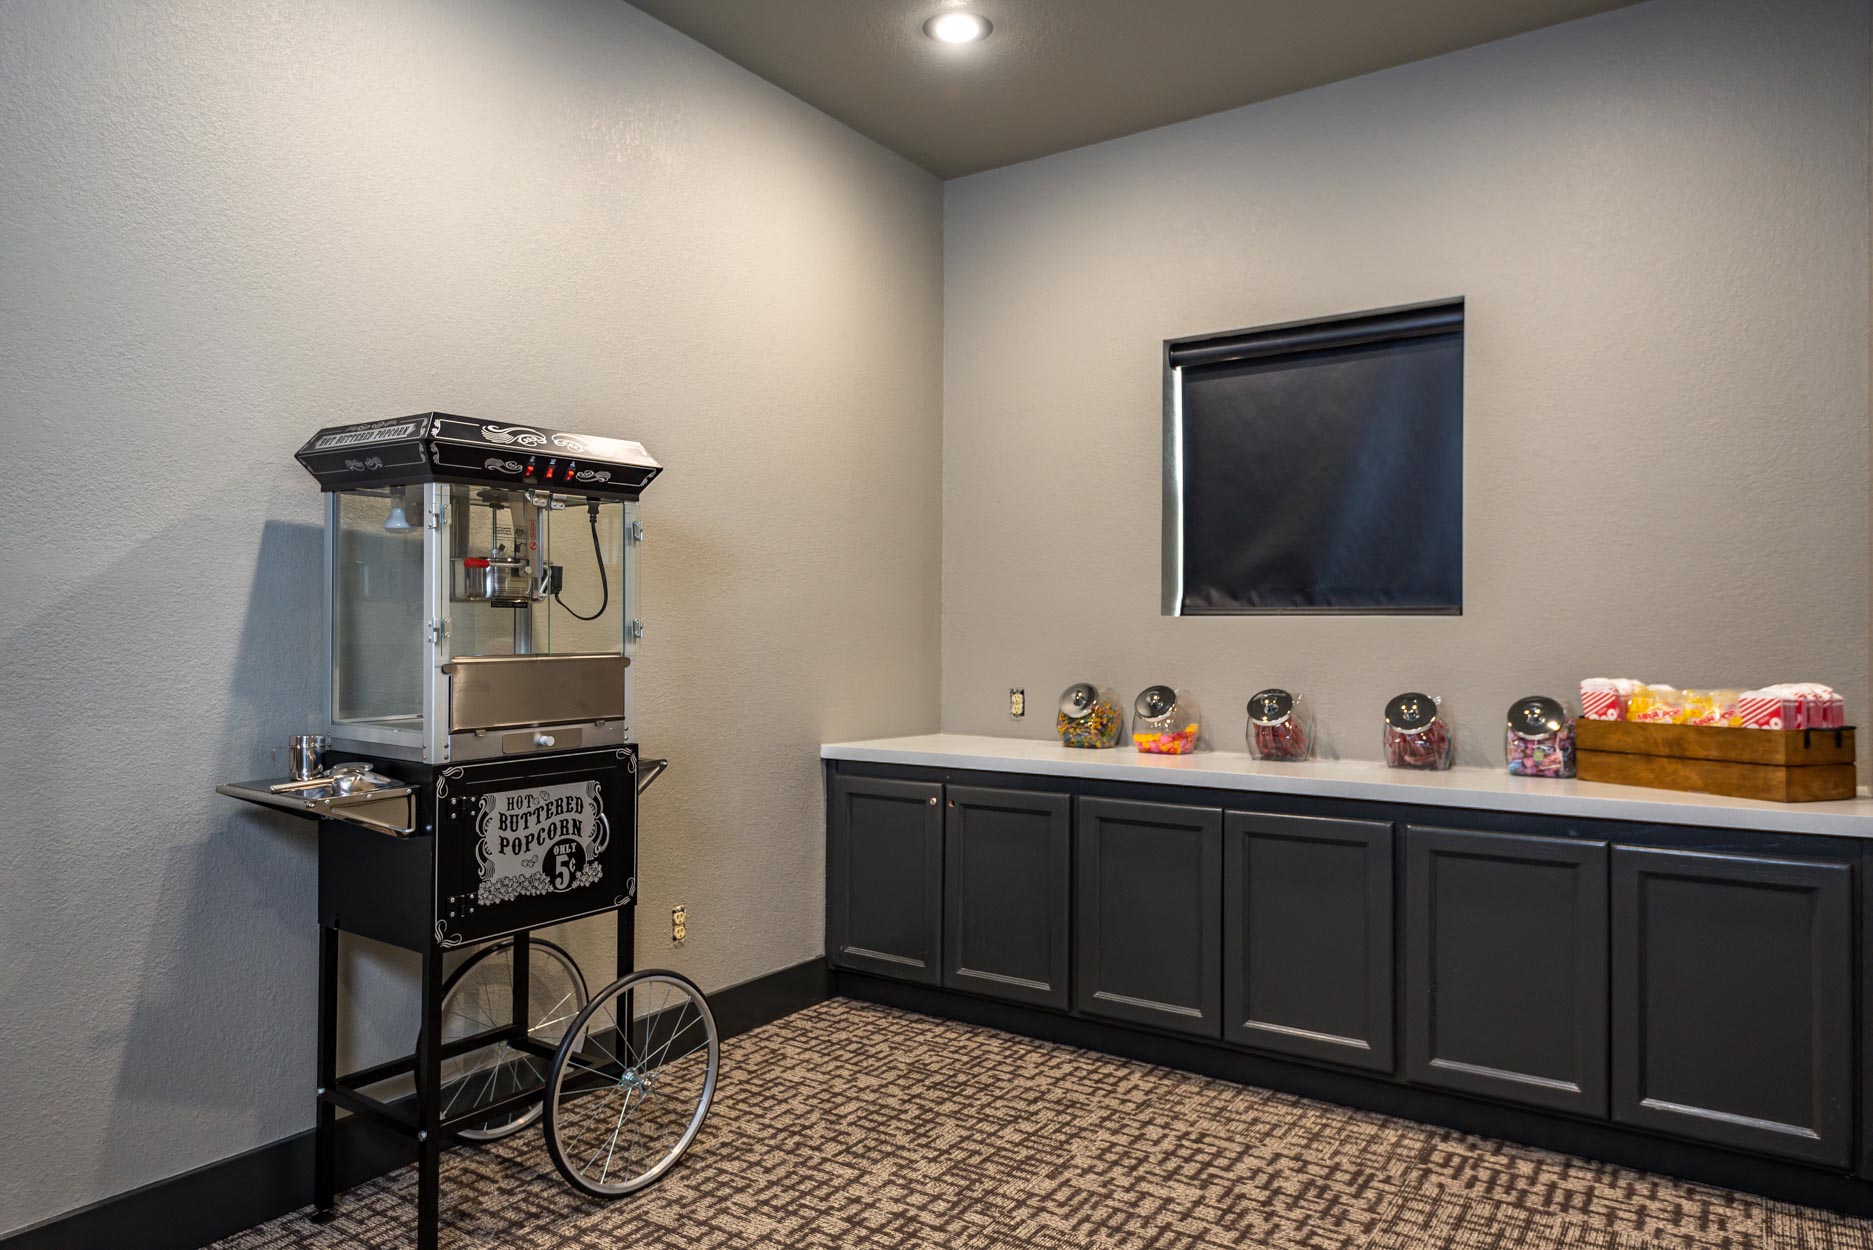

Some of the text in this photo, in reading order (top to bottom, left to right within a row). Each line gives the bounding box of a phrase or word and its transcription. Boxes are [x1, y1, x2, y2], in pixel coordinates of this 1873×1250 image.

[319, 426, 411, 447] HOT BUTTERED POPCORN
[1662, 708, 1681, 717] POP
[506, 794, 534, 811] HOT
[498, 797, 585, 832] BUTTERED
[498, 818, 583, 856] POPCORN
[553, 842, 578, 856] ONLY
[554, 854, 576, 890] 5¢
